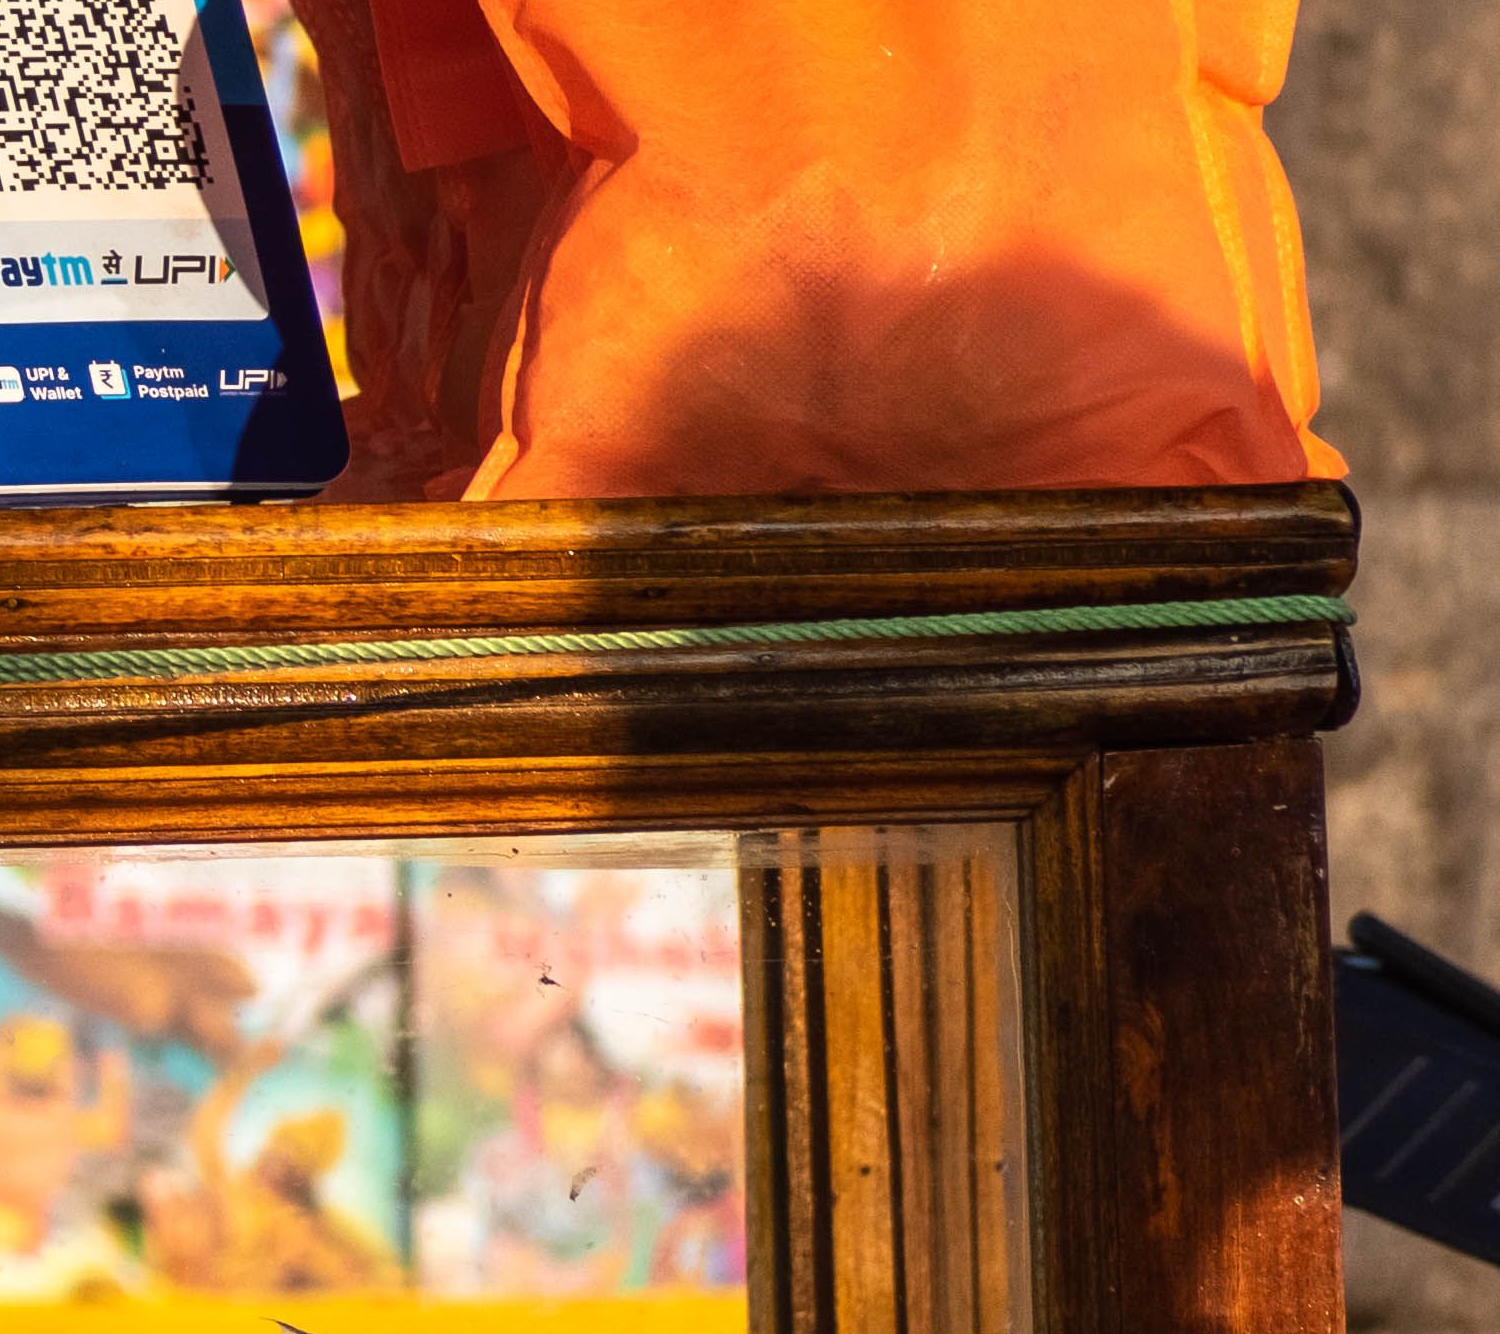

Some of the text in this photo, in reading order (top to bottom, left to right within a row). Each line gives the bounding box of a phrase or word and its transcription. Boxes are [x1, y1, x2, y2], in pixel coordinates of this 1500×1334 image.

[135, 255, 217, 284] UPI
[26, 367, 69, 382] UPI &
[133, 366, 185, 381] Paytm
[220, 370, 276, 390] UPI
[30, 386, 83, 400] Wallet
[138, 384, 209, 401] Postpaid
